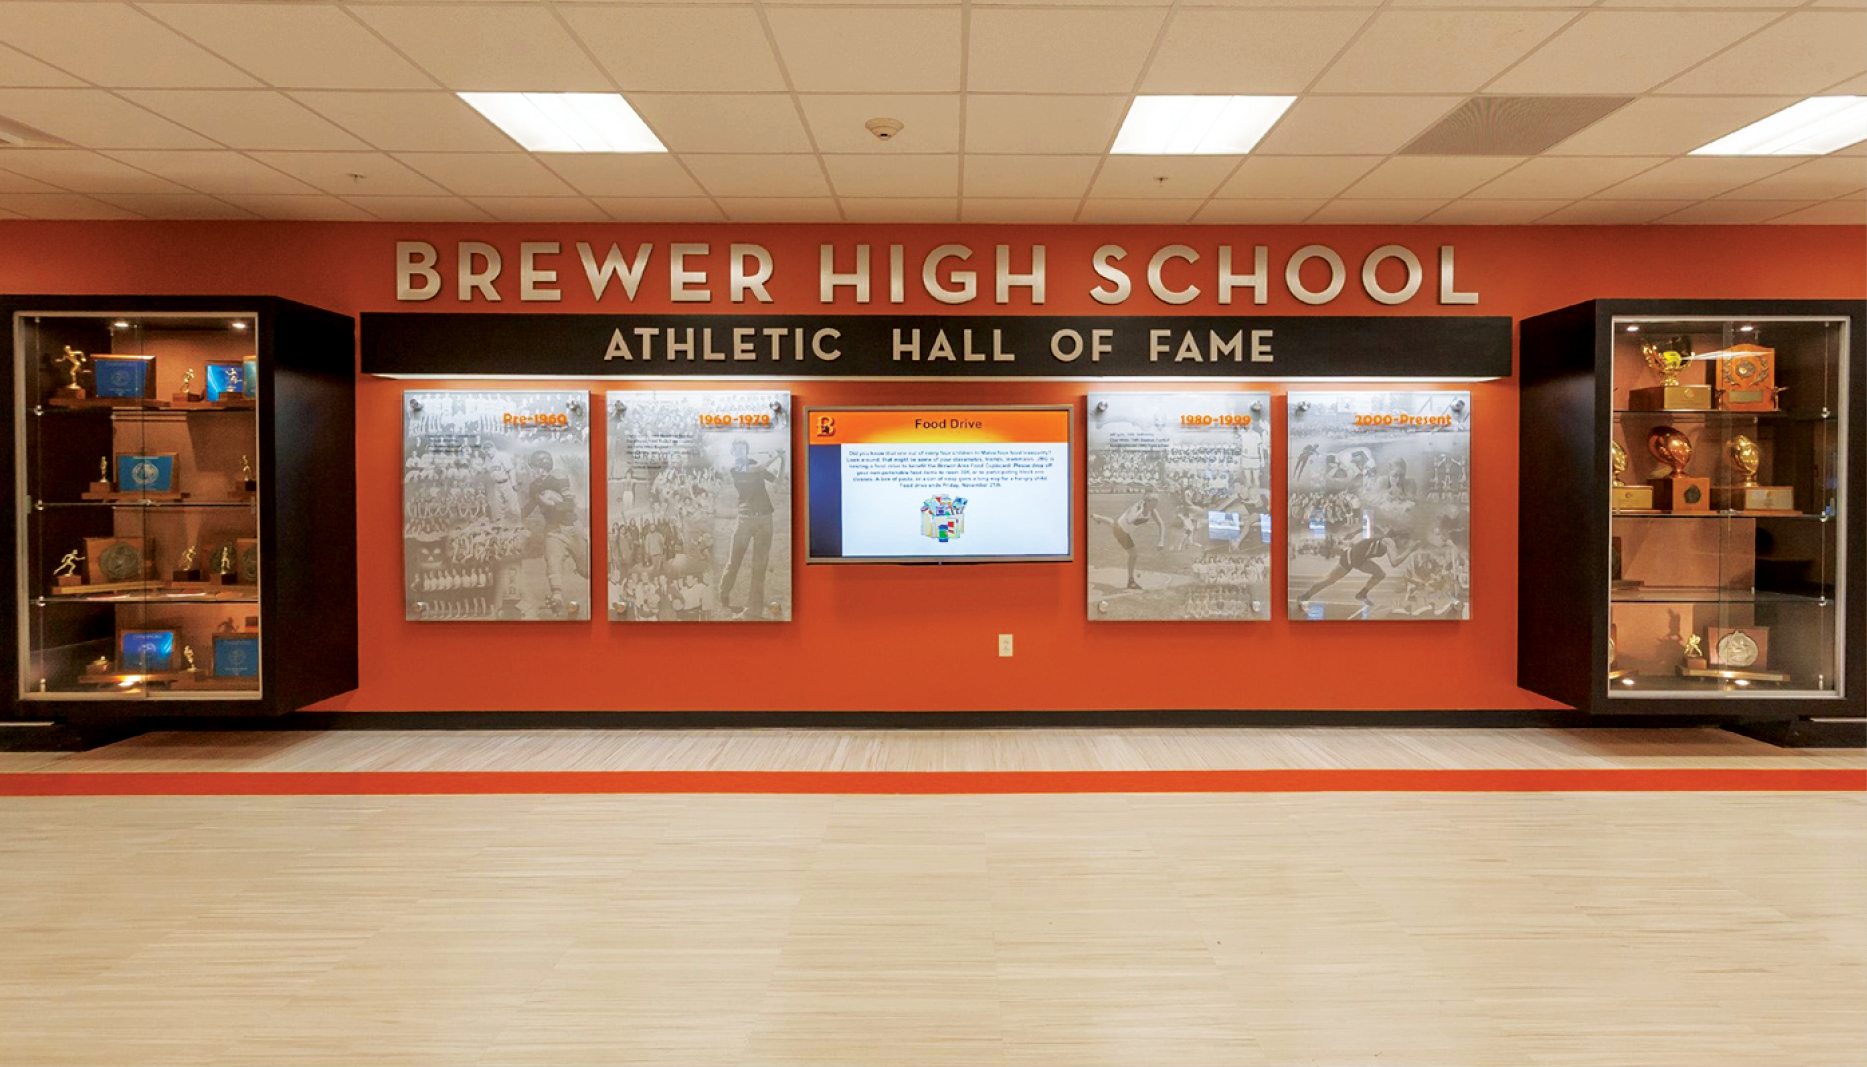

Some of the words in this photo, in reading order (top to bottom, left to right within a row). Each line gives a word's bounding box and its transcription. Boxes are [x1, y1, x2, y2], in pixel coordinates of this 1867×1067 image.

[396, 241, 774, 302] BREWER
[820, 244, 1045, 304] HIGH
[1089, 244, 1479, 305] SCHOOL
[604, 327, 841, 361] ATHLETIC
[892, 328, 1015, 361] HALL
[1050, 328, 1114, 362] OF
[1149, 329, 1274, 362] FAME
[503, 413, 567, 426] Pre-1960
[698, 413, 771, 426] 1960-1979
[915, 418, 947, 429] Food
[950, 418, 983, 429] Drive
[1180, 414, 1251, 426] 1980-1999
[1354, 414, 1452, 426] 2000-Present
